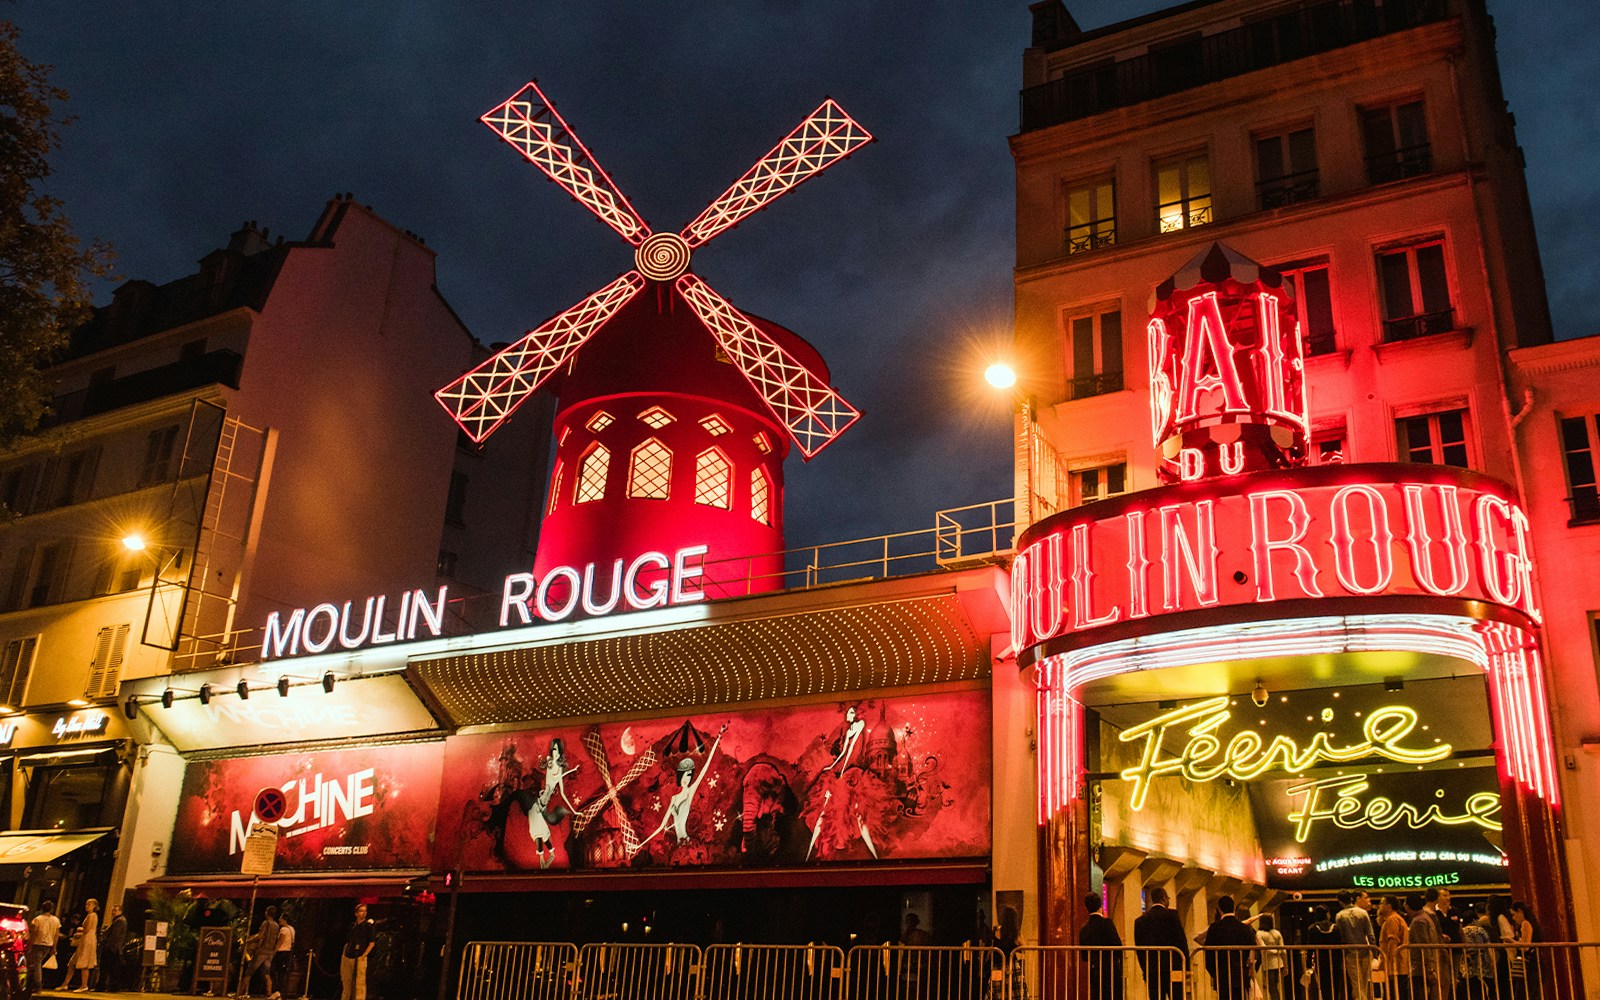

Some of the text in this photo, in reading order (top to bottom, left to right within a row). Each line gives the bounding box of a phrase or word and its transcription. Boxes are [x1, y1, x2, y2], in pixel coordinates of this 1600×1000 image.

[1147, 291, 1309, 449] BAL
[1180, 441, 1245, 480] DU
[261, 544, 709, 659] MOULIN ROUGE
[1009, 500, 1220, 656] OULIN
[1118, 696, 1453, 812] Féerie
[229, 767, 374, 856] MCHINE
[1286, 773, 1503, 843] Féerie
[323, 845, 369, 855] CONCERTS CLUB
[1328, 858, 1349, 870] PLUS
[1353, 872, 1460, 888] LES DORISS GIRLS
